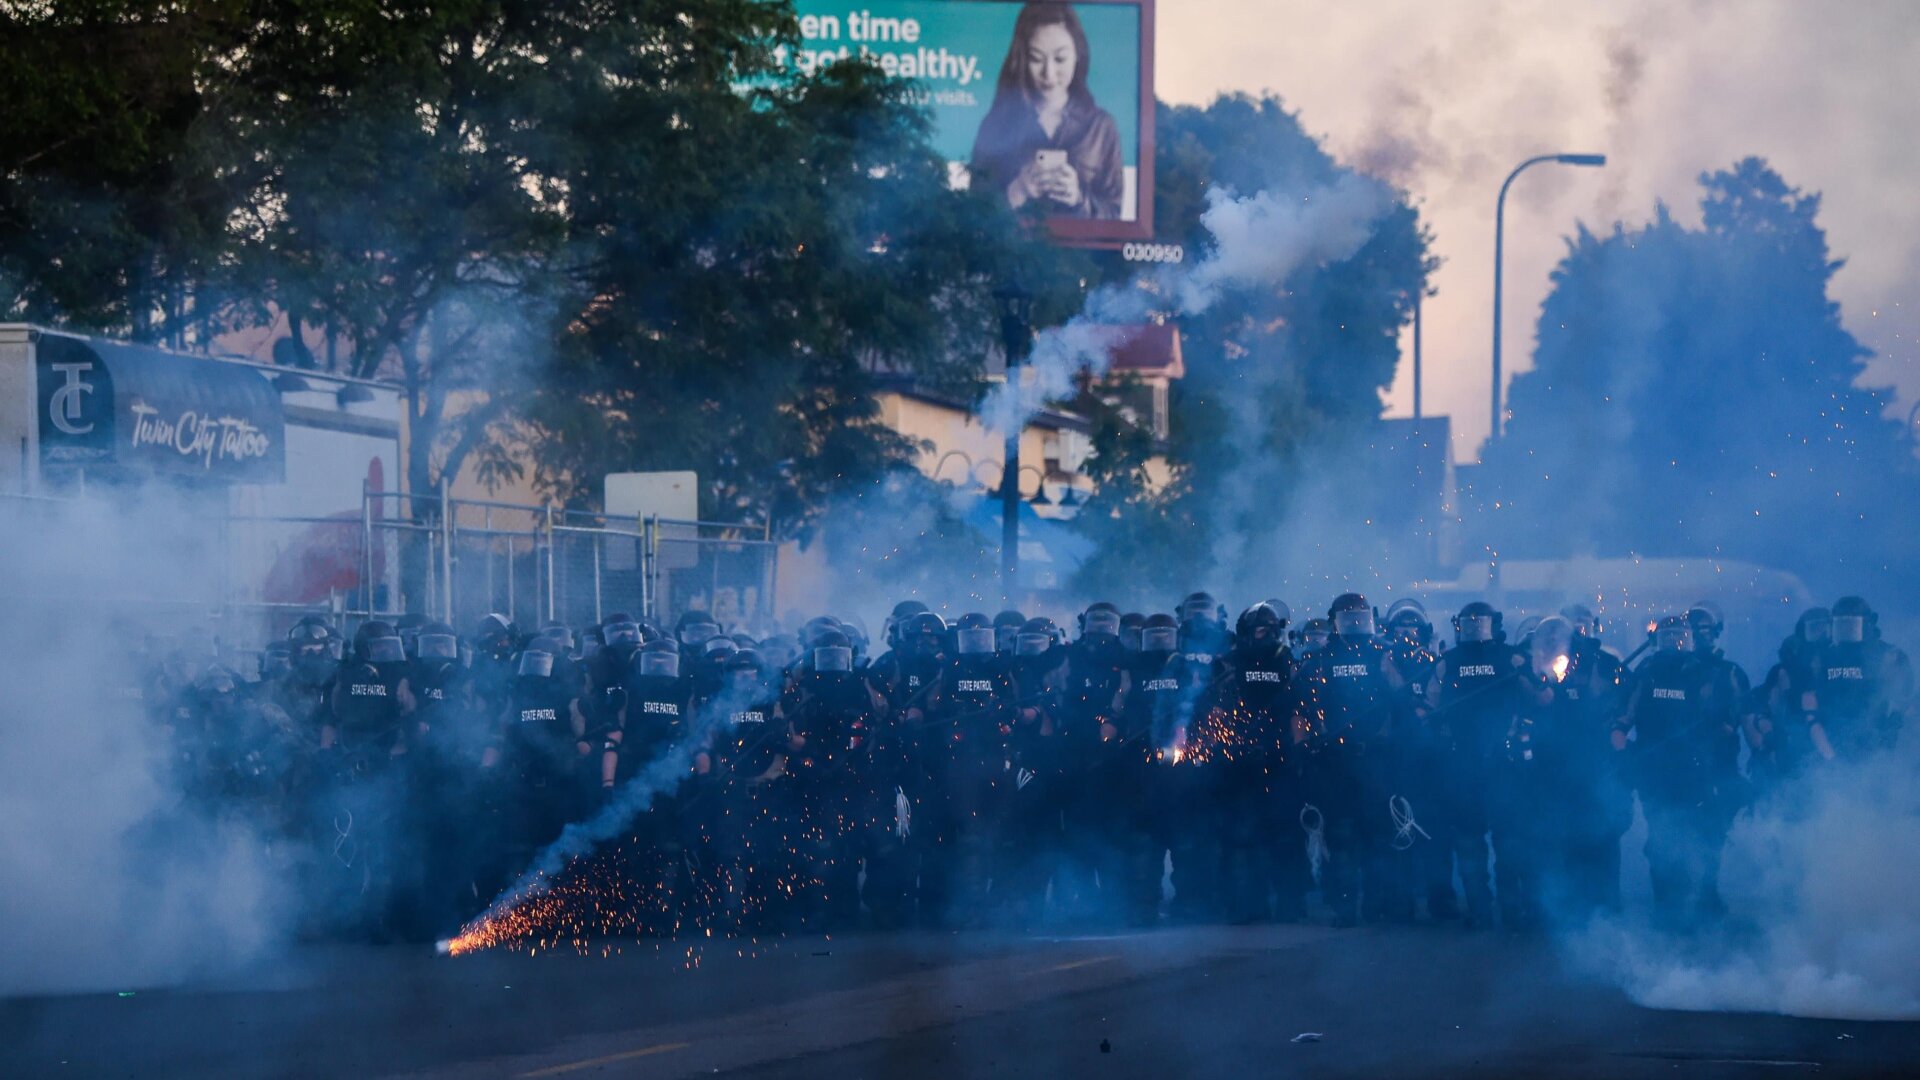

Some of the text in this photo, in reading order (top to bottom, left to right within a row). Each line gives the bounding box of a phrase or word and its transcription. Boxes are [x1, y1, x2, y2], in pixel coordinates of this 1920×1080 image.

[848, 10, 920, 42] time
[1123, 243, 1183, 263] 030950
[131, 402, 269, 469] Twin City Tattoo
[1245, 671, 1280, 682] STATE PATROL
[1333, 664, 1368, 677] STATE PATROL
[1460, 664, 1495, 677] STATE PATROL
[351, 684, 387, 696] STATE PATROL
[958, 679, 993, 692] STATE PATROL
[1159, 678, 1178, 690] PATROL
[521, 708, 556, 721] STATE PATROL
[643, 701, 679, 715] STATE PATROL
[745, 711, 764, 723] PATROL
